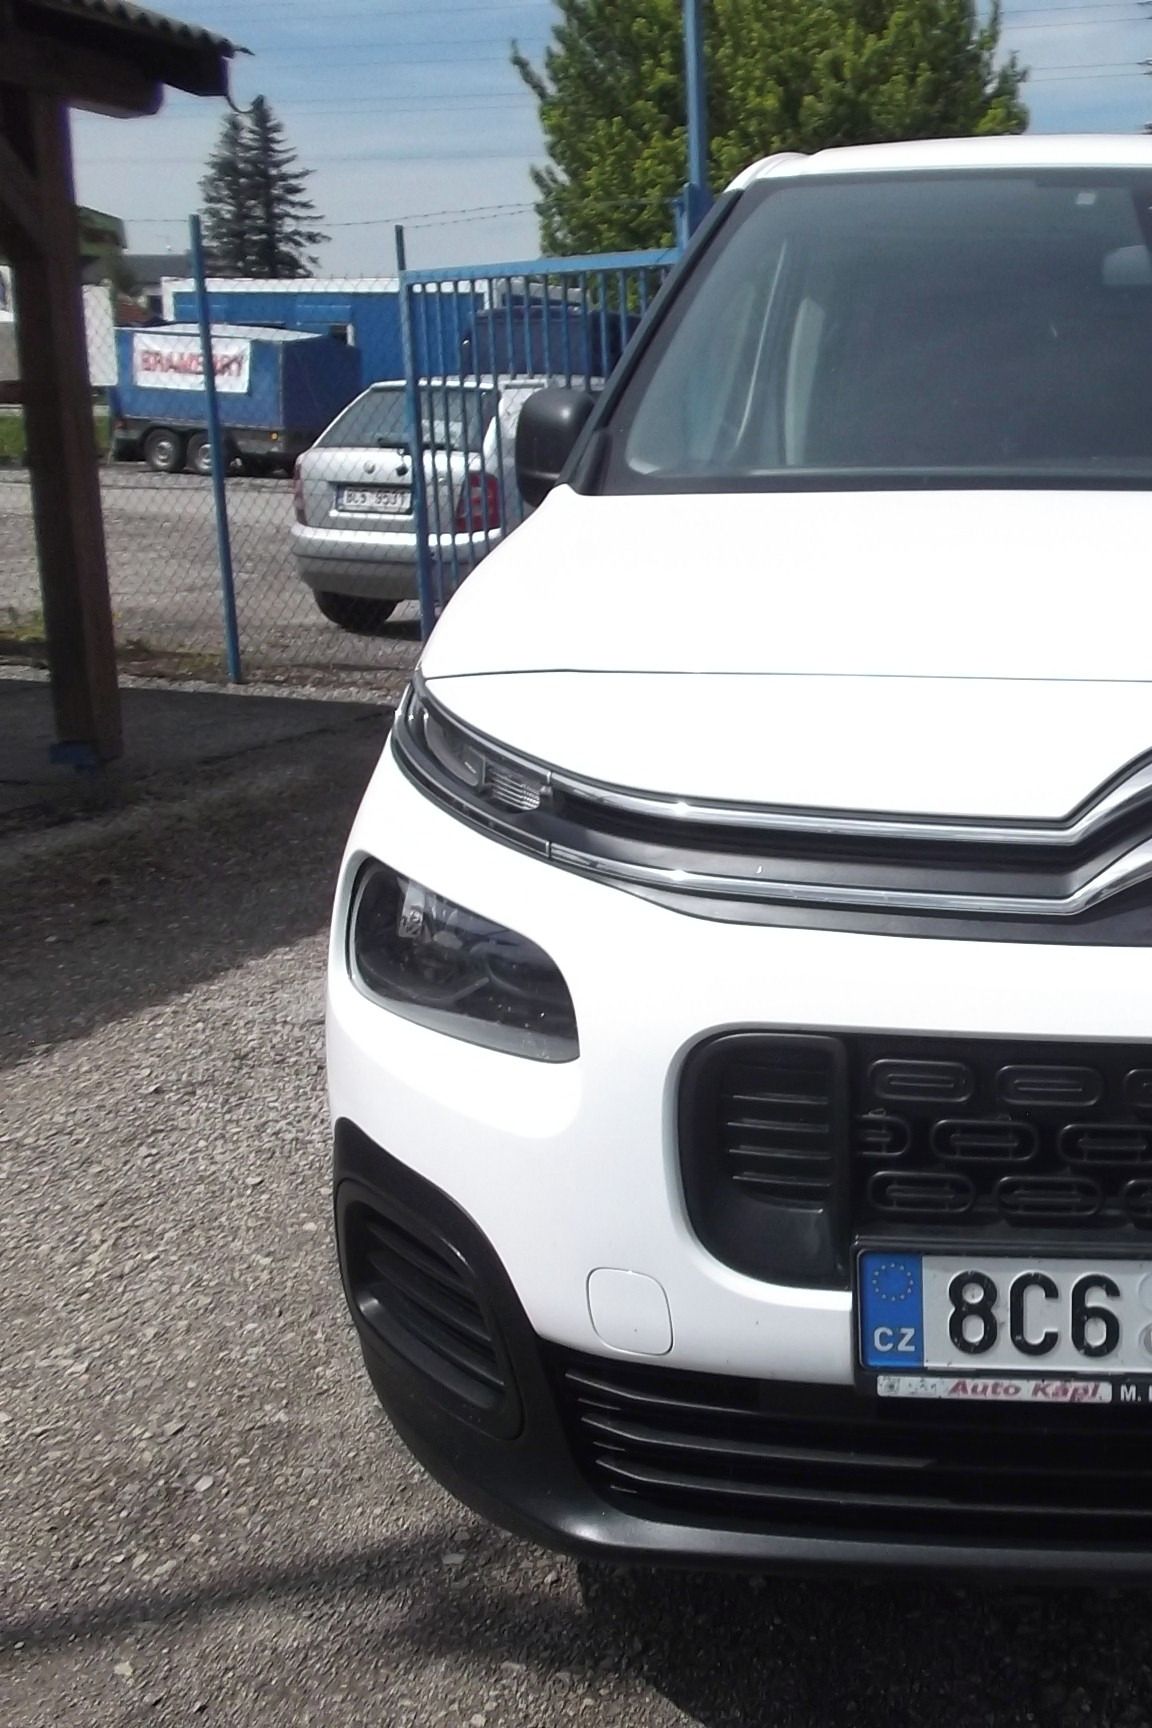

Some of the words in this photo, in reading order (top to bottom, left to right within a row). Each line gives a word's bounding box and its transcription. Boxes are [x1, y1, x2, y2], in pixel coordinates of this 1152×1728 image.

[141, 349, 244, 377] BRAMBRY
[949, 1270, 1121, 1357] 8C6
[873, 1327, 916, 1352] CZ
[949, 1379, 1022, 1397] Auto
[1120, 1384, 1141, 1402] M.
